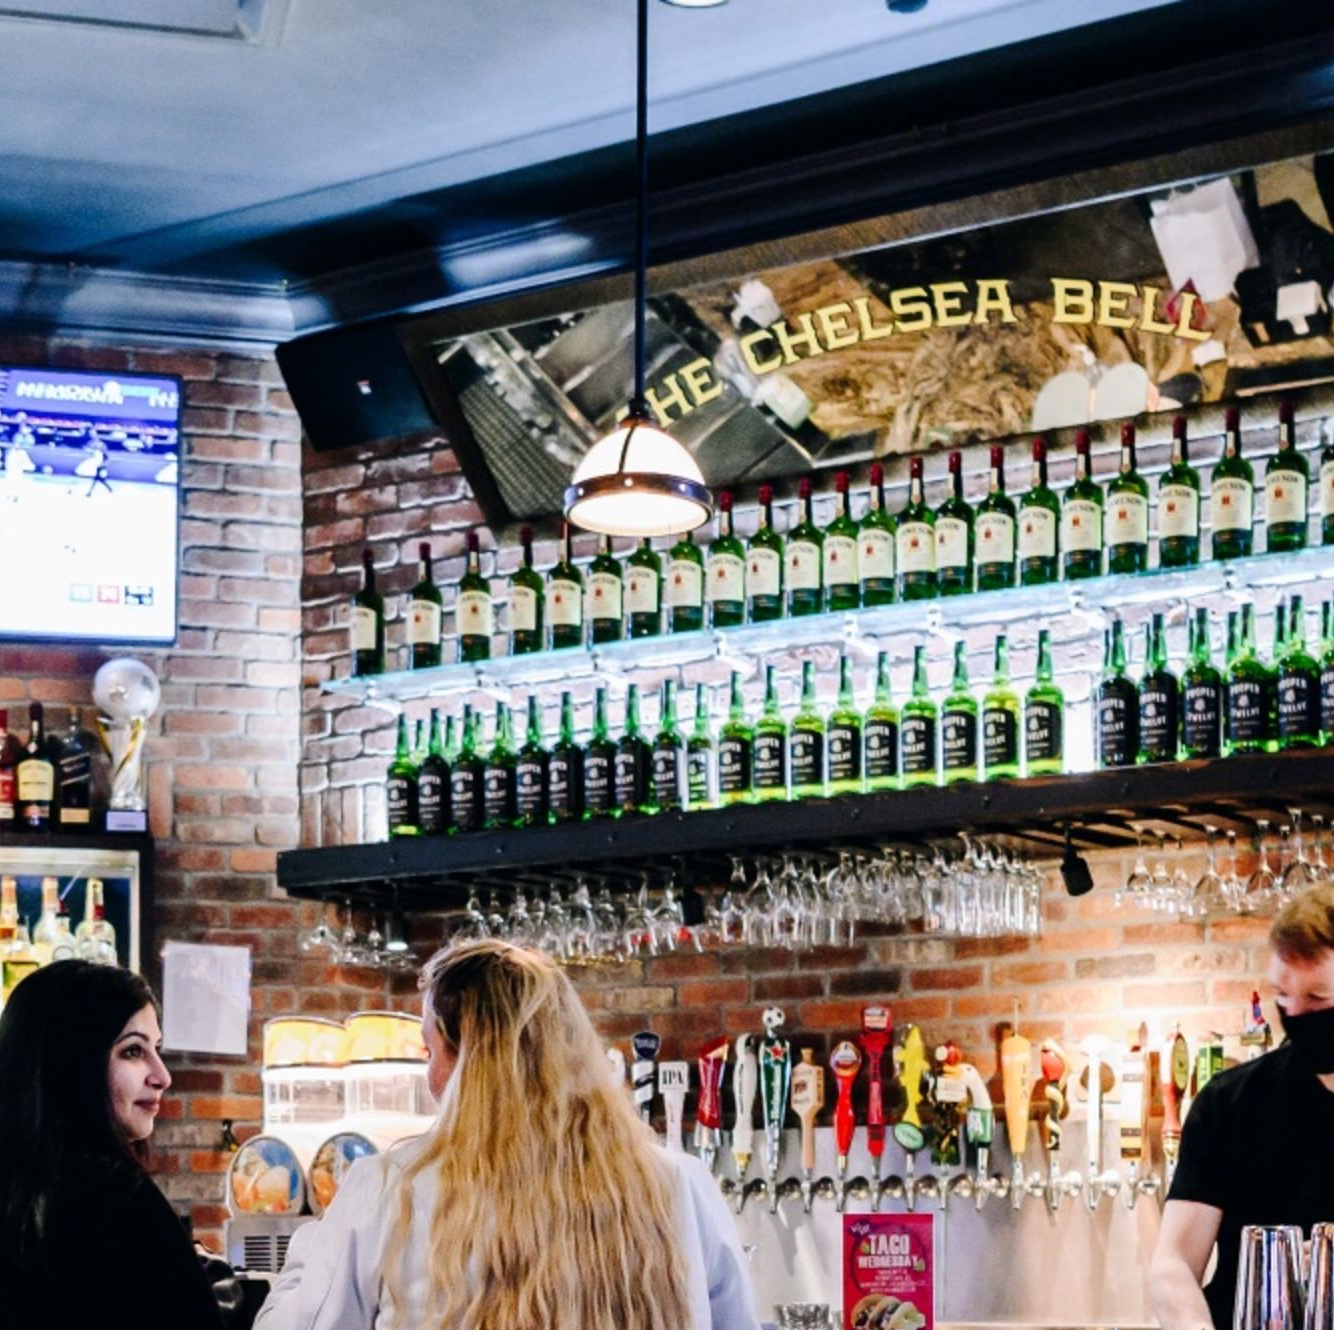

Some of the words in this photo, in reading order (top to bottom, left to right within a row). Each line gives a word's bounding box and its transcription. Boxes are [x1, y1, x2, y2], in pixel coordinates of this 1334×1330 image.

[616, 356, 728, 429] HE
[738, 278, 1016, 376] CHELSEA
[1049, 277, 1214, 342] BELL
[661, 1069, 684, 1085] IPA
[869, 1234, 910, 1255] TACO
